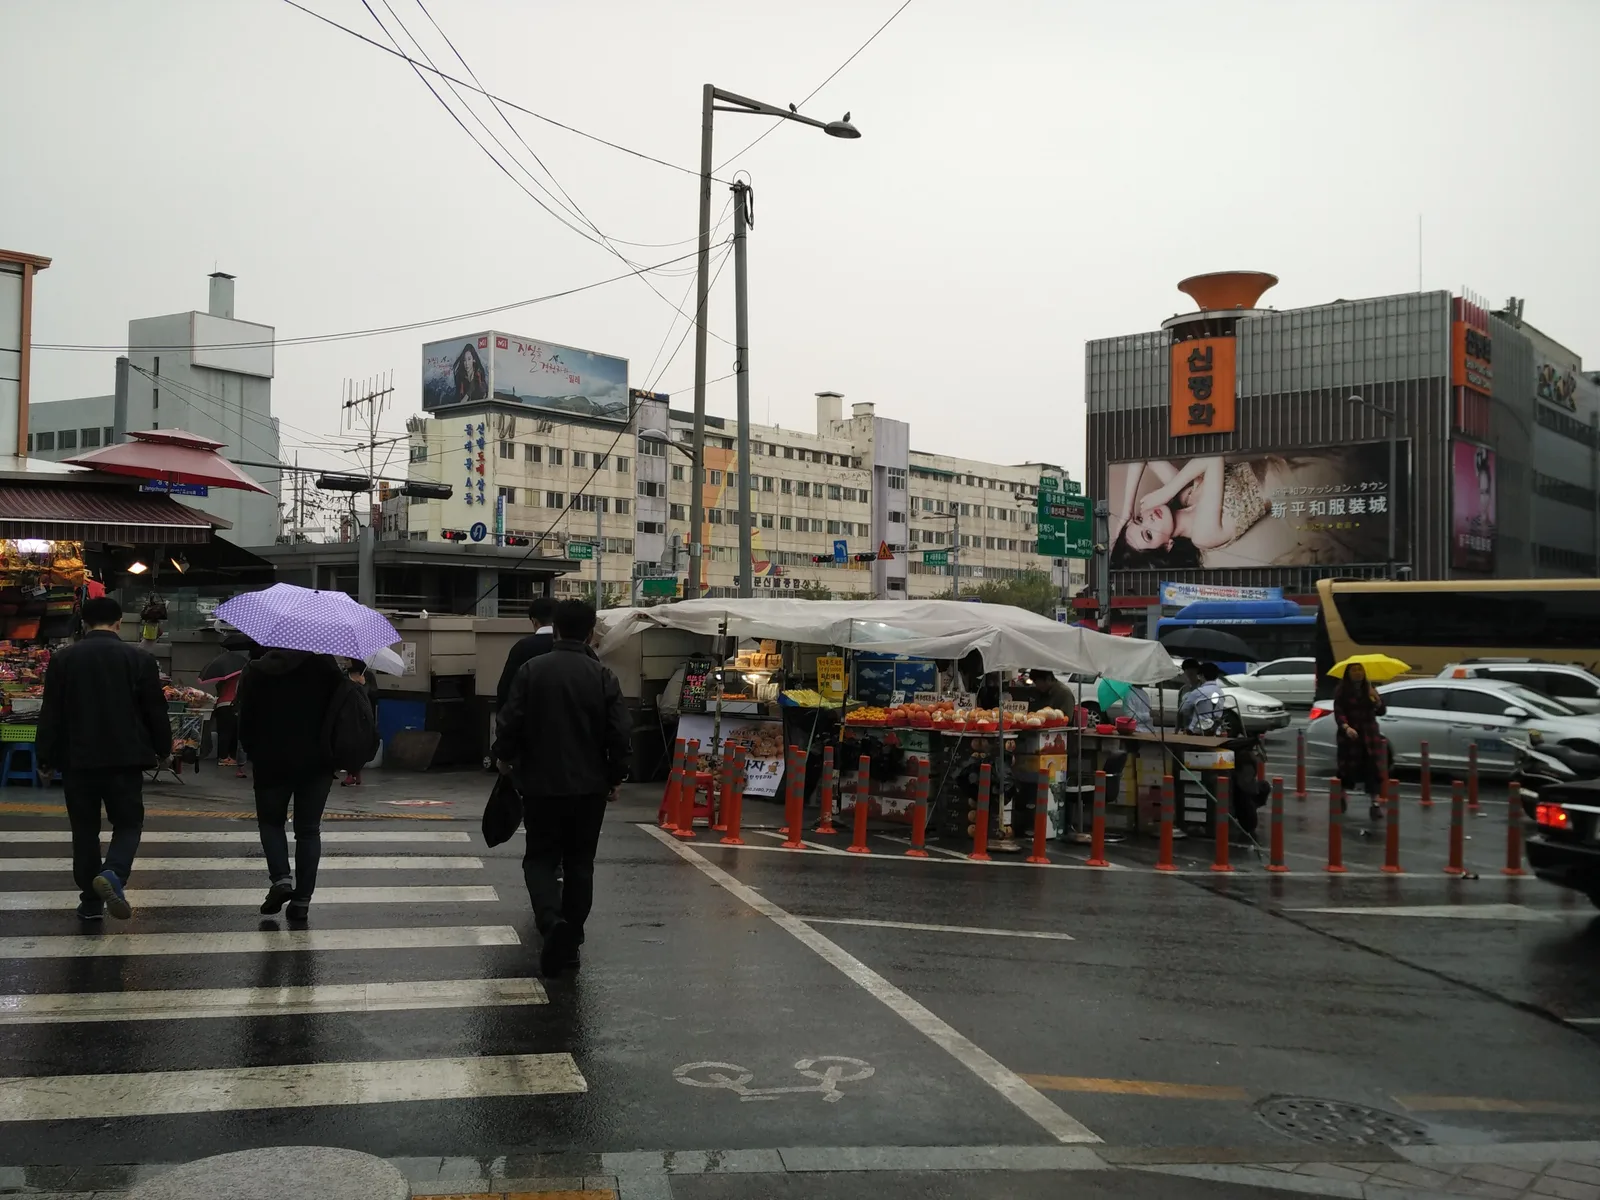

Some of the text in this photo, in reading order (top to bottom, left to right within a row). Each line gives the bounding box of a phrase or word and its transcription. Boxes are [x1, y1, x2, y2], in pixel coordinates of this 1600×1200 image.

[1187, 346, 1215, 427] 신평화
[1271, 496, 1389, 518] 新平和服裝城
